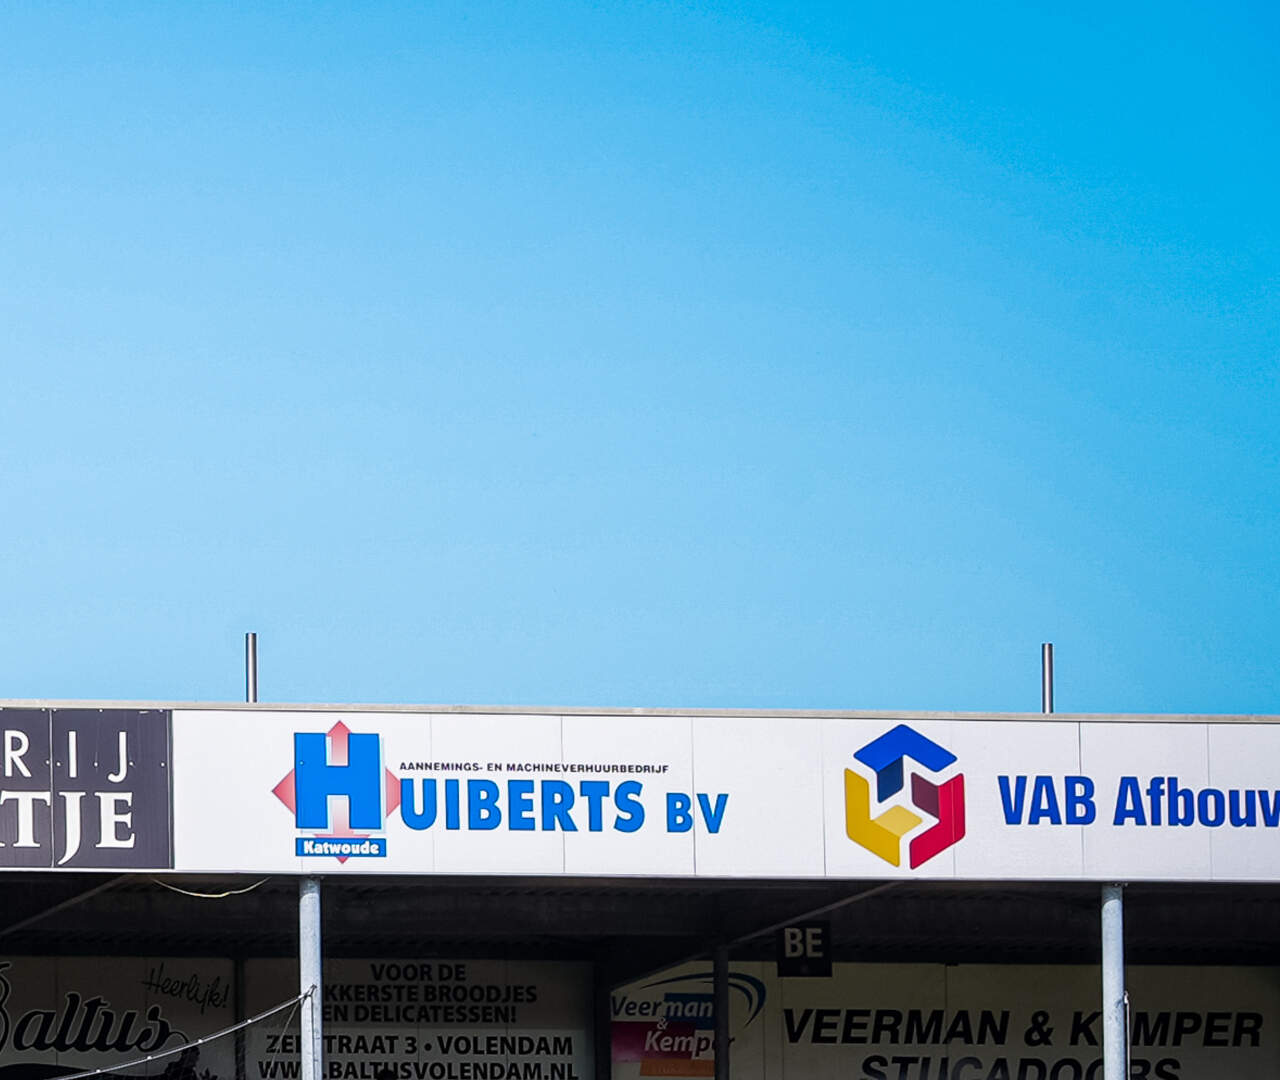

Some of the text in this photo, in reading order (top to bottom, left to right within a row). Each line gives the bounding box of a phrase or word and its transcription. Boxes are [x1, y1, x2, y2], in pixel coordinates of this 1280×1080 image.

[400, 762, 669, 774] AANNEMINGS- EN MACHINEVERHUURBEDRIJF
[997, 775, 1096, 825] VAB
[666, 793, 728, 834] BV
[303, 840, 379, 855] Katwoude
[784, 928, 824, 959] BE
[371, 963, 466, 981] VOOR DE
[324, 985, 537, 1003] KKERSTE BROODJES
[355, 1006, 517, 1023] DELICATESSEN!
[611, 996, 713, 1017] Veerman
[783, 1009, 1263, 1047] VEERMAN & KMPER
[266, 1035, 573, 1055] ZETRAAT 3 VOLENDAM
[644, 1030, 735, 1058] Kempr
[258, 1061, 578, 1080] WW.BALTUSVOLENDAM.NL
